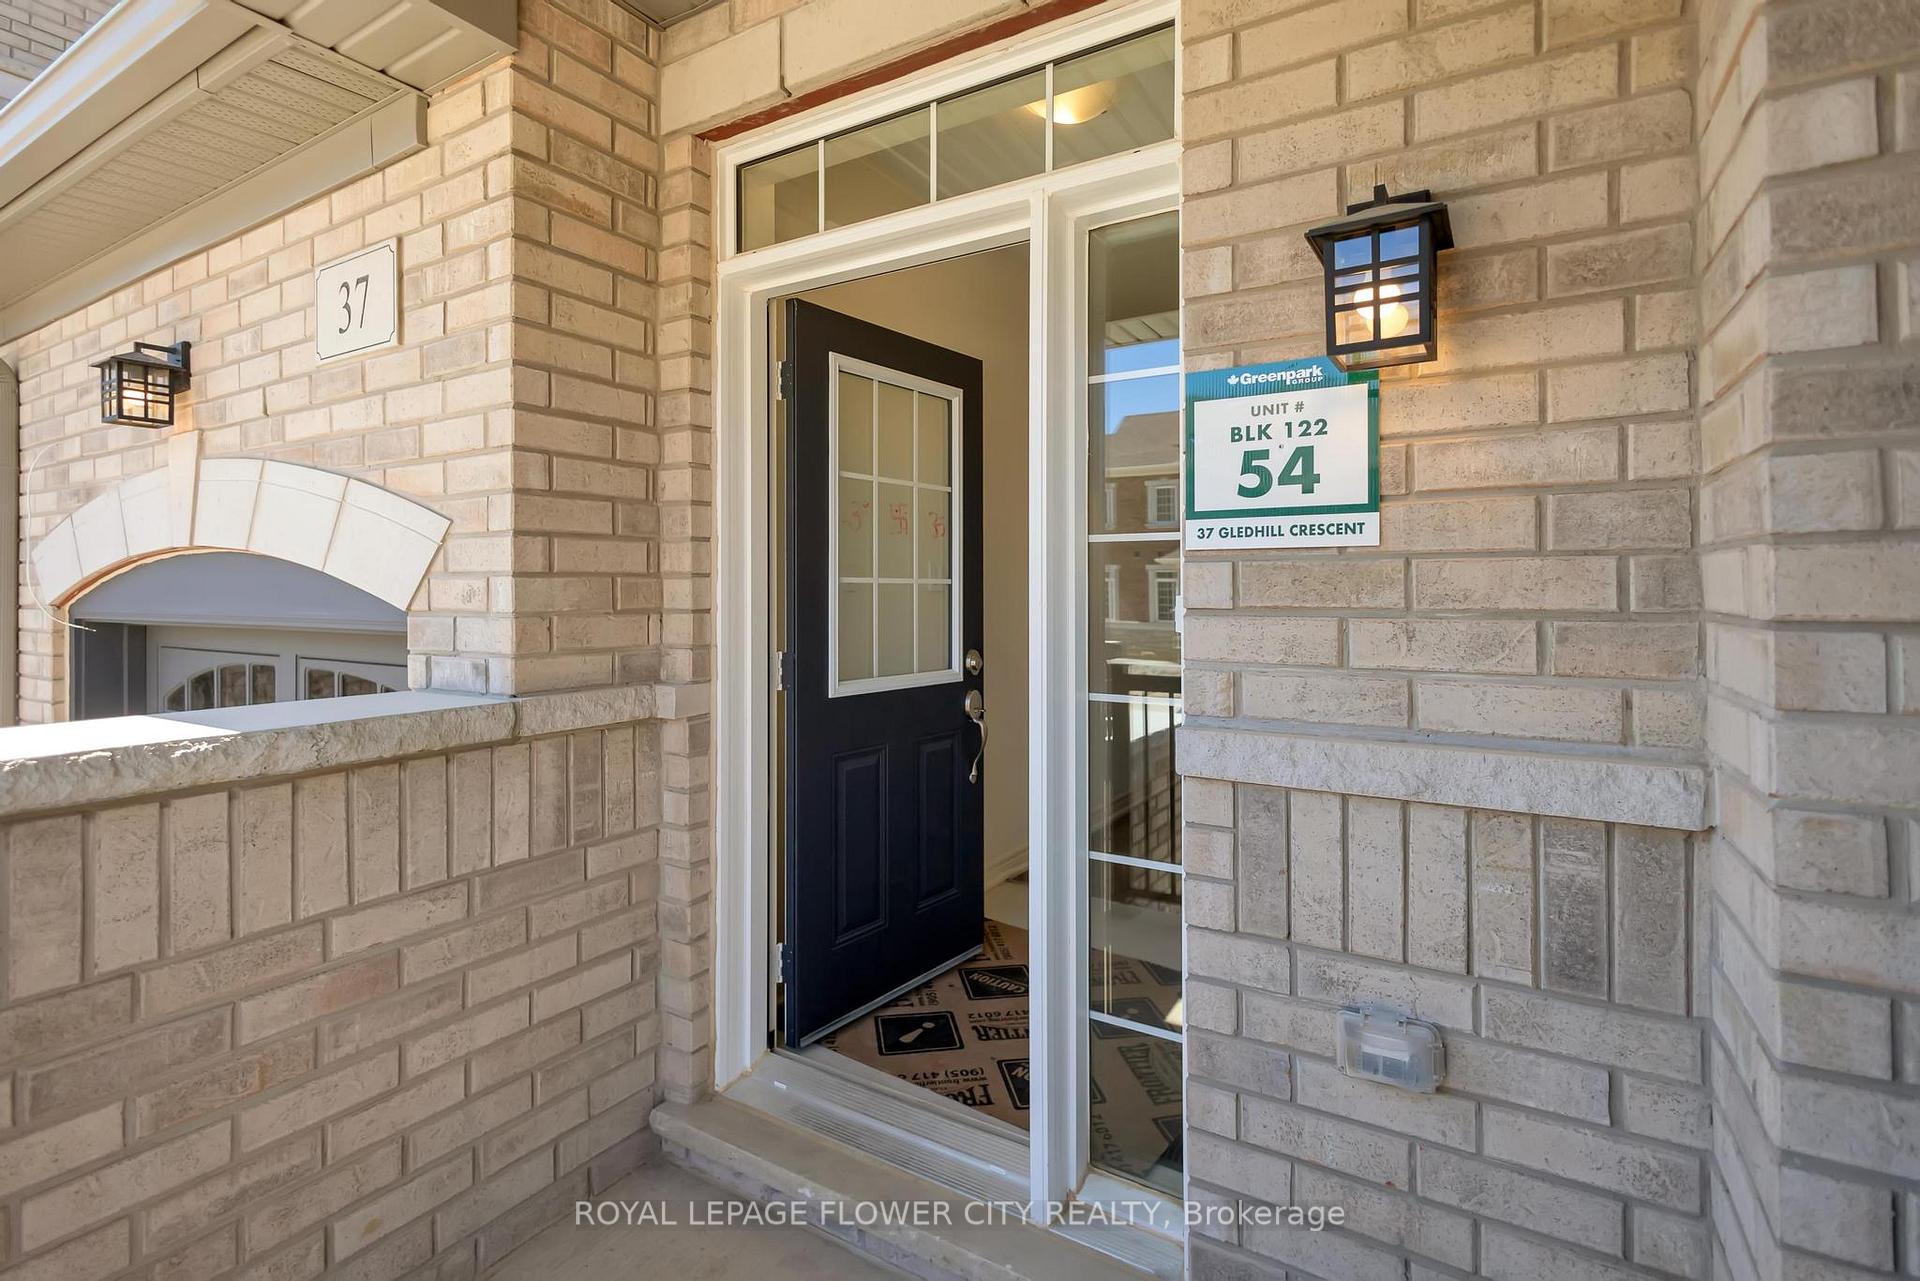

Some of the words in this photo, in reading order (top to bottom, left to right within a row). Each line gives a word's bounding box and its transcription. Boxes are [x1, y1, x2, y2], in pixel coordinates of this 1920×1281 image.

[338, 274, 369, 334] 37
[1240, 365, 1323, 385] Greenpark
[1292, 376, 1324, 386] GROUP
[1251, 403, 1289, 417] UNIT
[1295, 401, 1305, 413] #
[1230, 423, 1273, 443] BLK
[1284, 418, 1328, 438] 122
[1237, 445, 1321, 498] 54
[1197, 528, 1214, 539] 37
[1218, 525, 1285, 539] GLEDHILL
[1290, 522, 1365, 537] CRESCENT
[969, 972, 1026, 994] CAUTION
[945, 1067, 985, 1078] (905)
